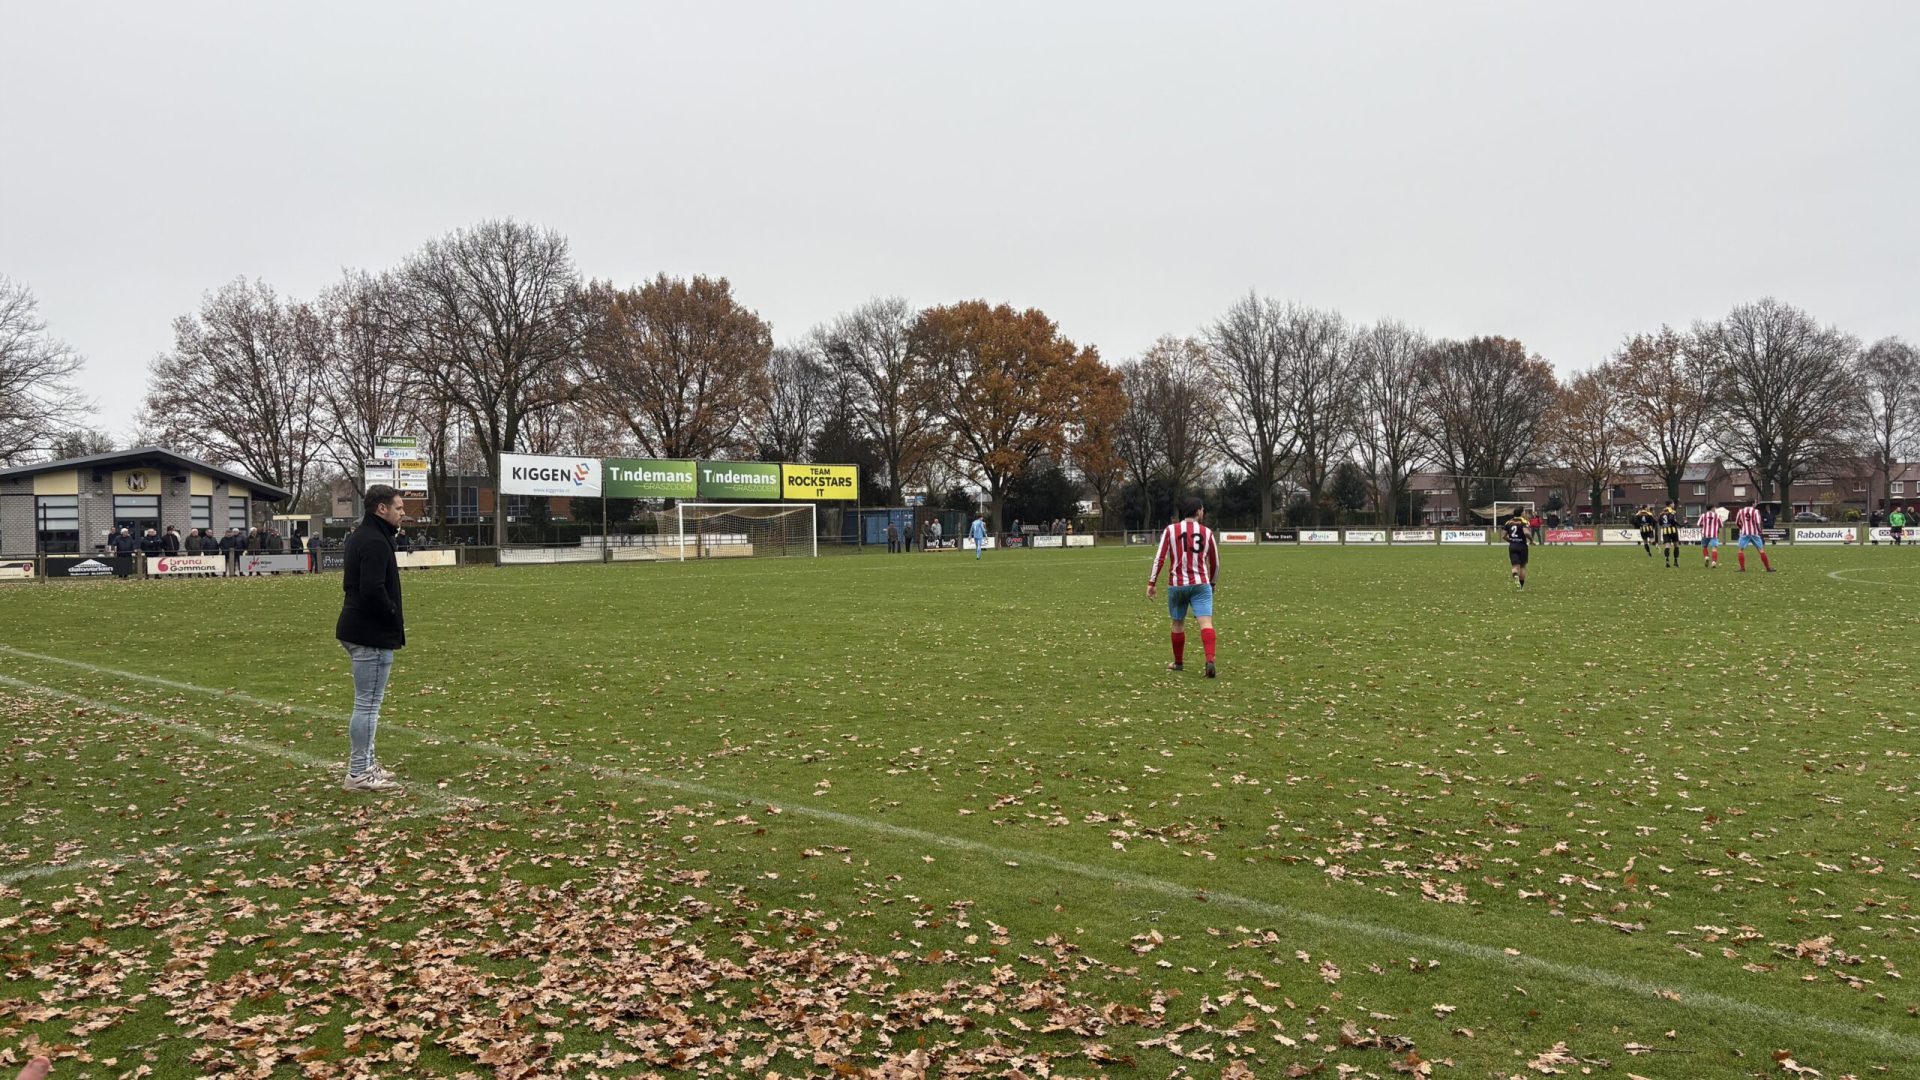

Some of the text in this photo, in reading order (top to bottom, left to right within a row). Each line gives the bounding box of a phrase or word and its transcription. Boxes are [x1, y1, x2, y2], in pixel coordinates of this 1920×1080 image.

[512, 467, 571, 482] KIGGEN
[609, 467, 693, 483] Tindemans
[703, 470, 777, 484] Tindemans
[788, 476, 852, 487] ROCKSTARS
[643, 483, 693, 491] GRASZODEN
[816, 489, 825, 497] IT
[1662, 514, 1668, 524] 3
[1707, 516, 1714, 526] 7
[1745, 512, 1751, 522] 9
[1511, 525, 1518, 537] 2
[1797, 530, 1844, 539] Rabobank
[1178, 531, 1204, 553] 13
